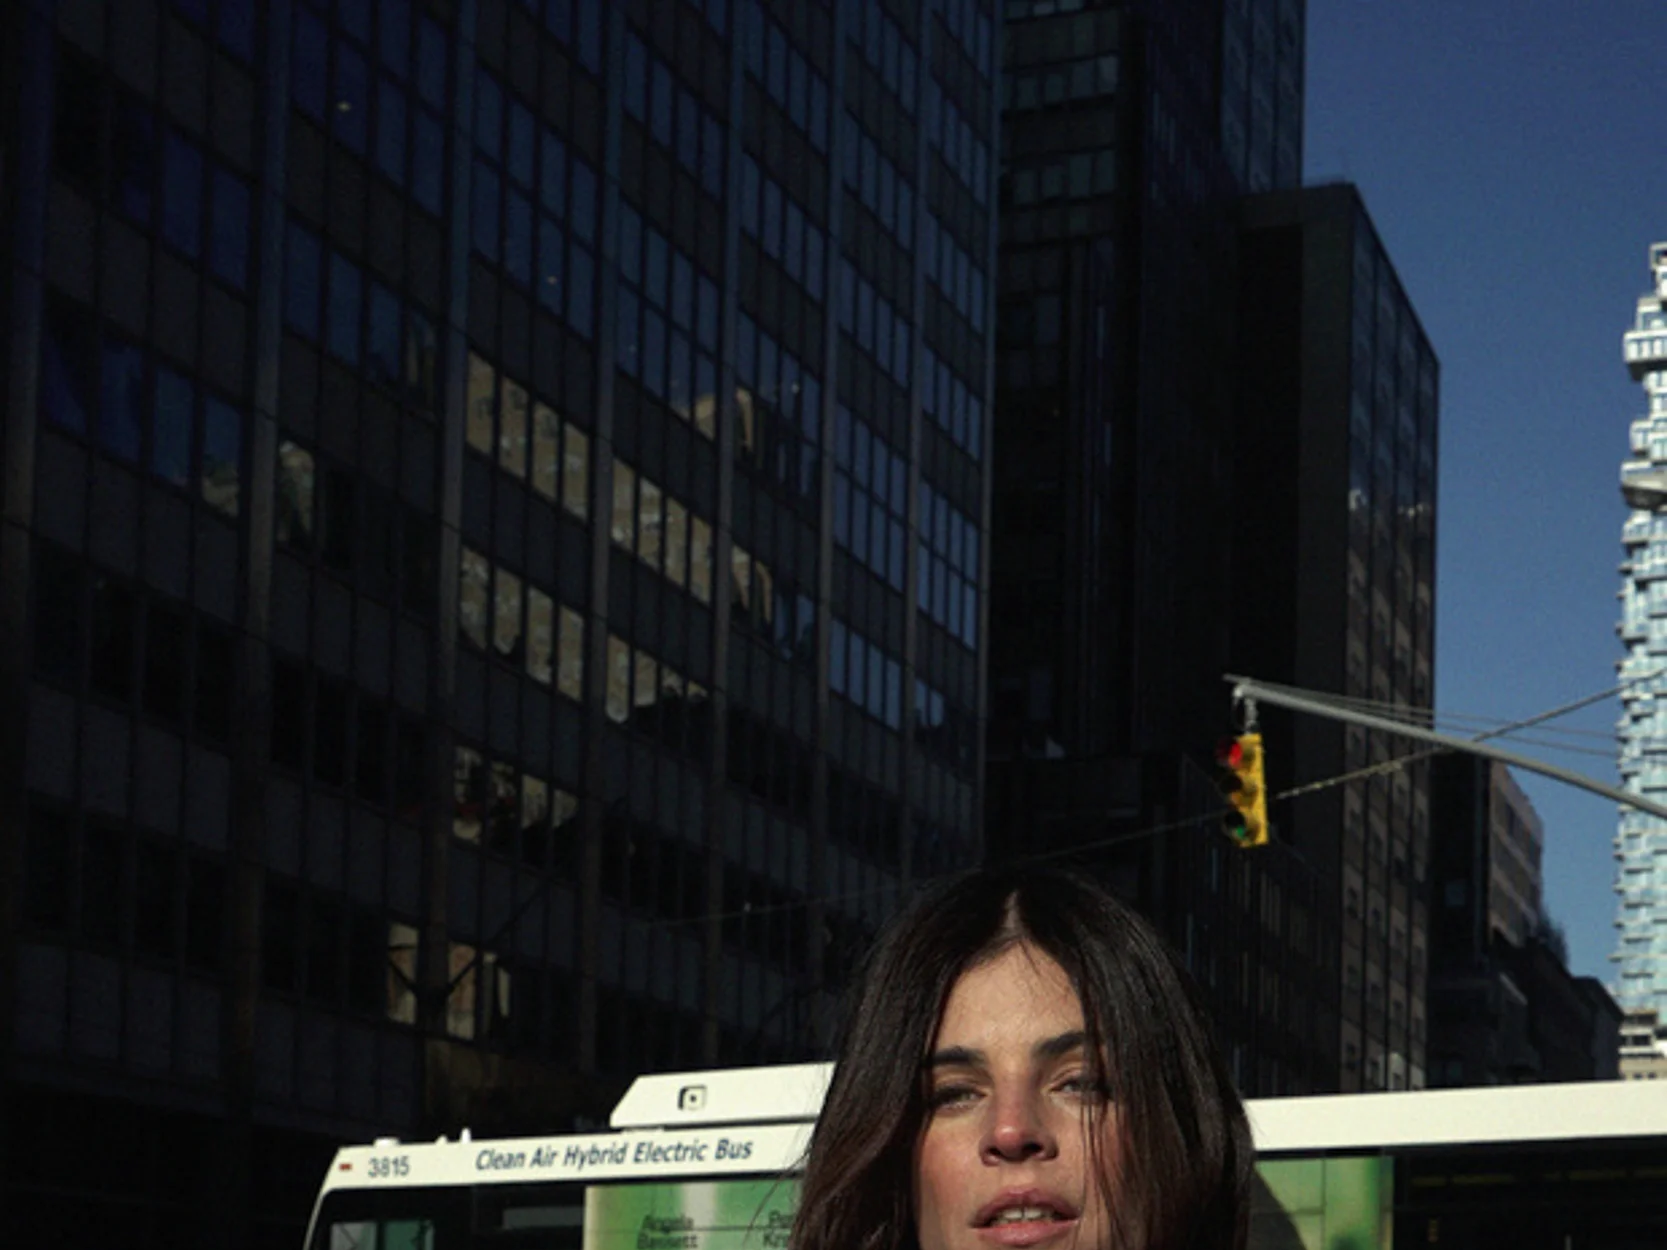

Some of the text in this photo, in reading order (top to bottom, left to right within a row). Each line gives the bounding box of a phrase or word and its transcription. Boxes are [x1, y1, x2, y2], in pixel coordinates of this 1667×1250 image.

[368, 1156, 410, 1177] 3815
[475, 1137, 753, 1172] Clean Air Hybrid Electric Bus
